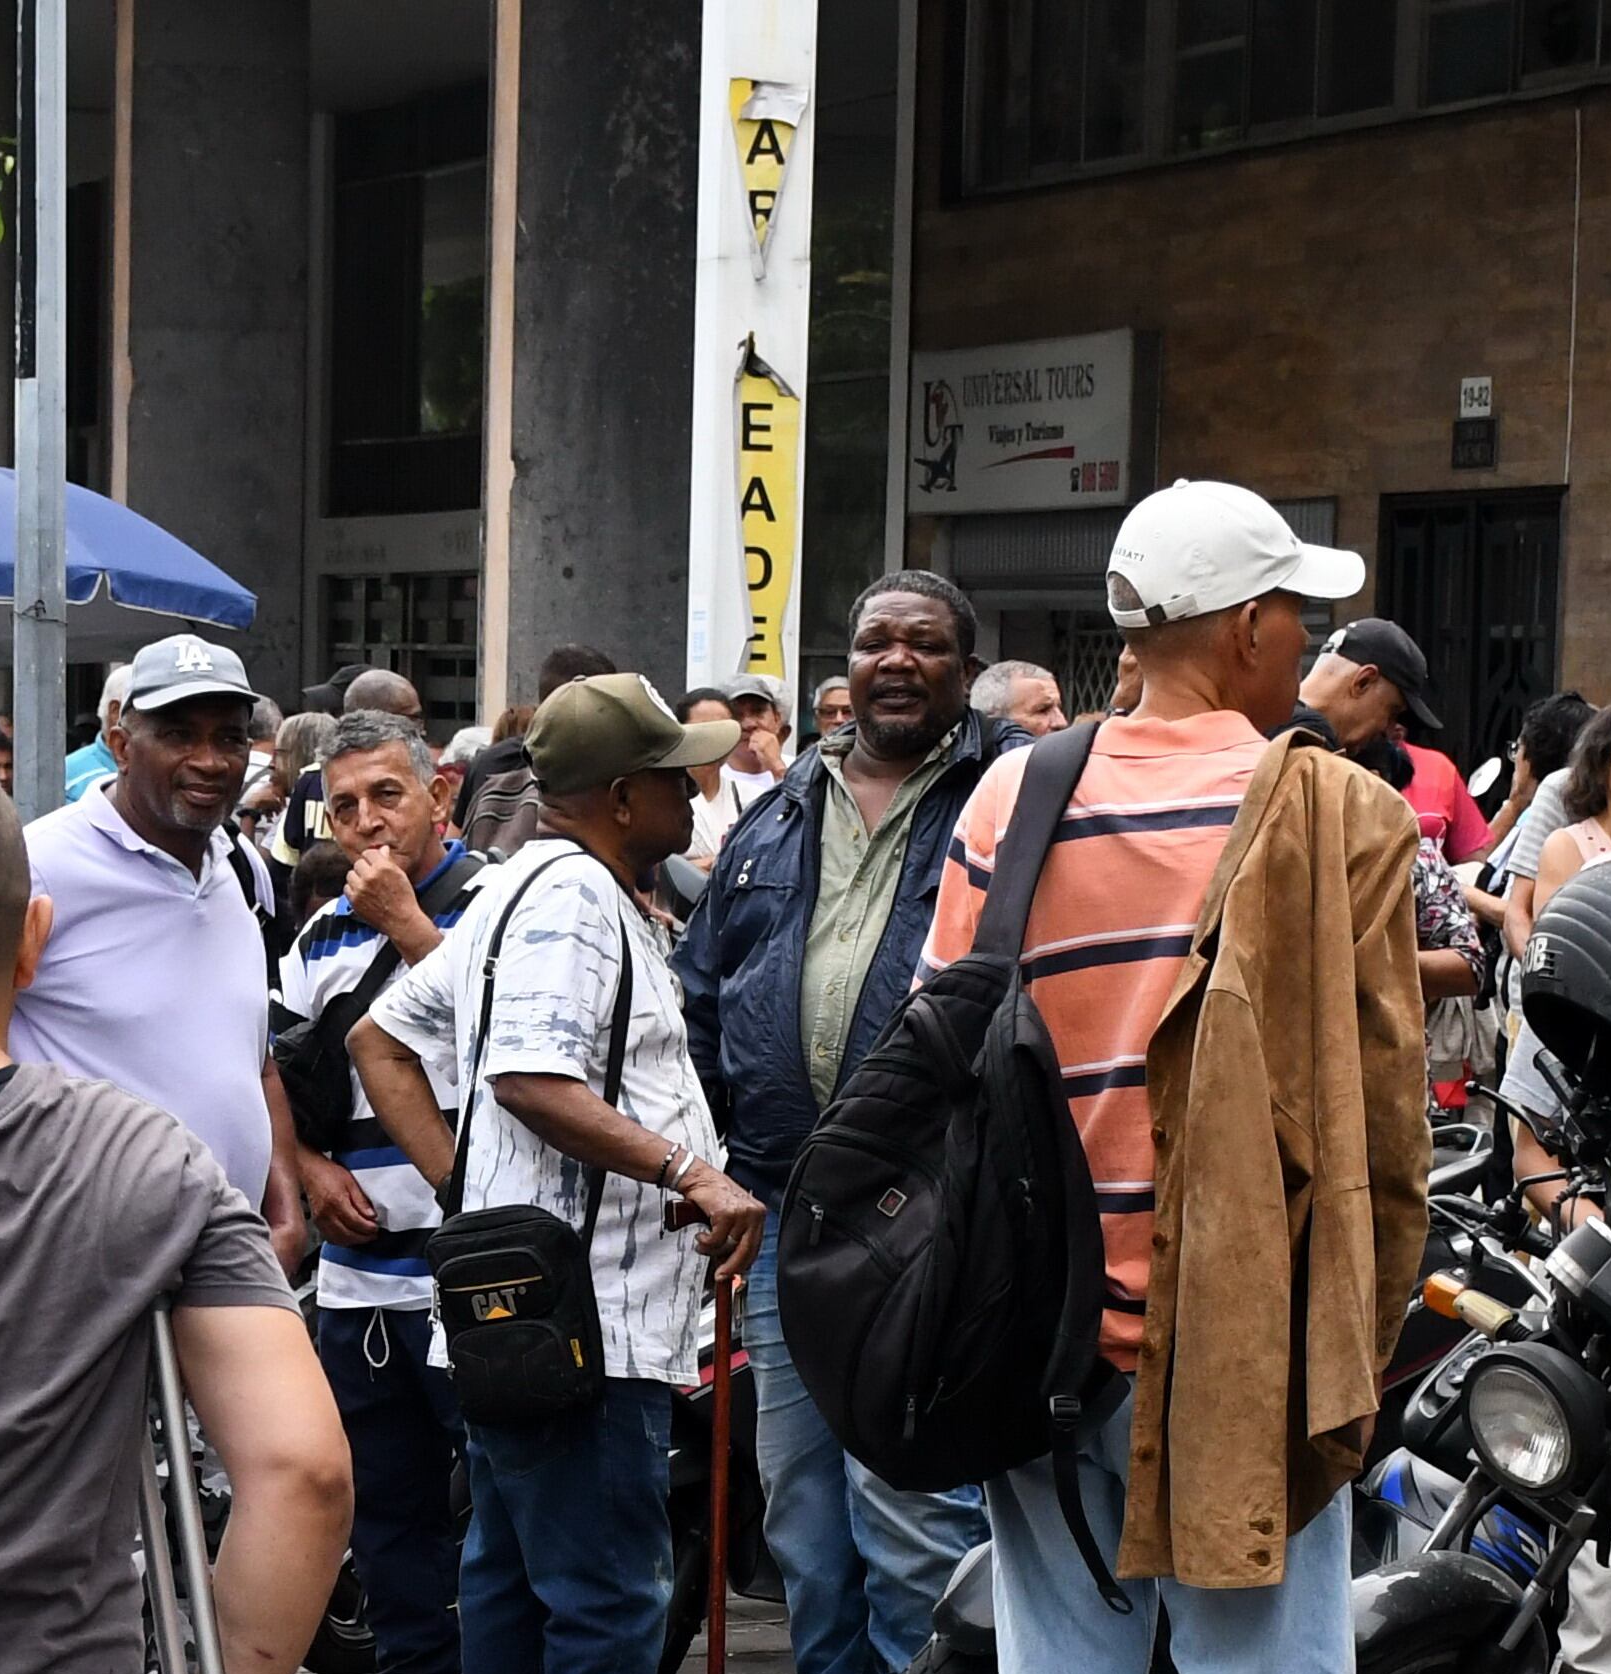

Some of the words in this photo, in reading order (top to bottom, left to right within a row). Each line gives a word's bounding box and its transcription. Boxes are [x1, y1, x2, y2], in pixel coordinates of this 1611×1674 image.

[963, 368, 1042, 408] UNIVERSAL
[1046, 363, 1095, 401] TOURS
[174, 640, 214, 673] LA
[471, 1288, 518, 1322] CAT
